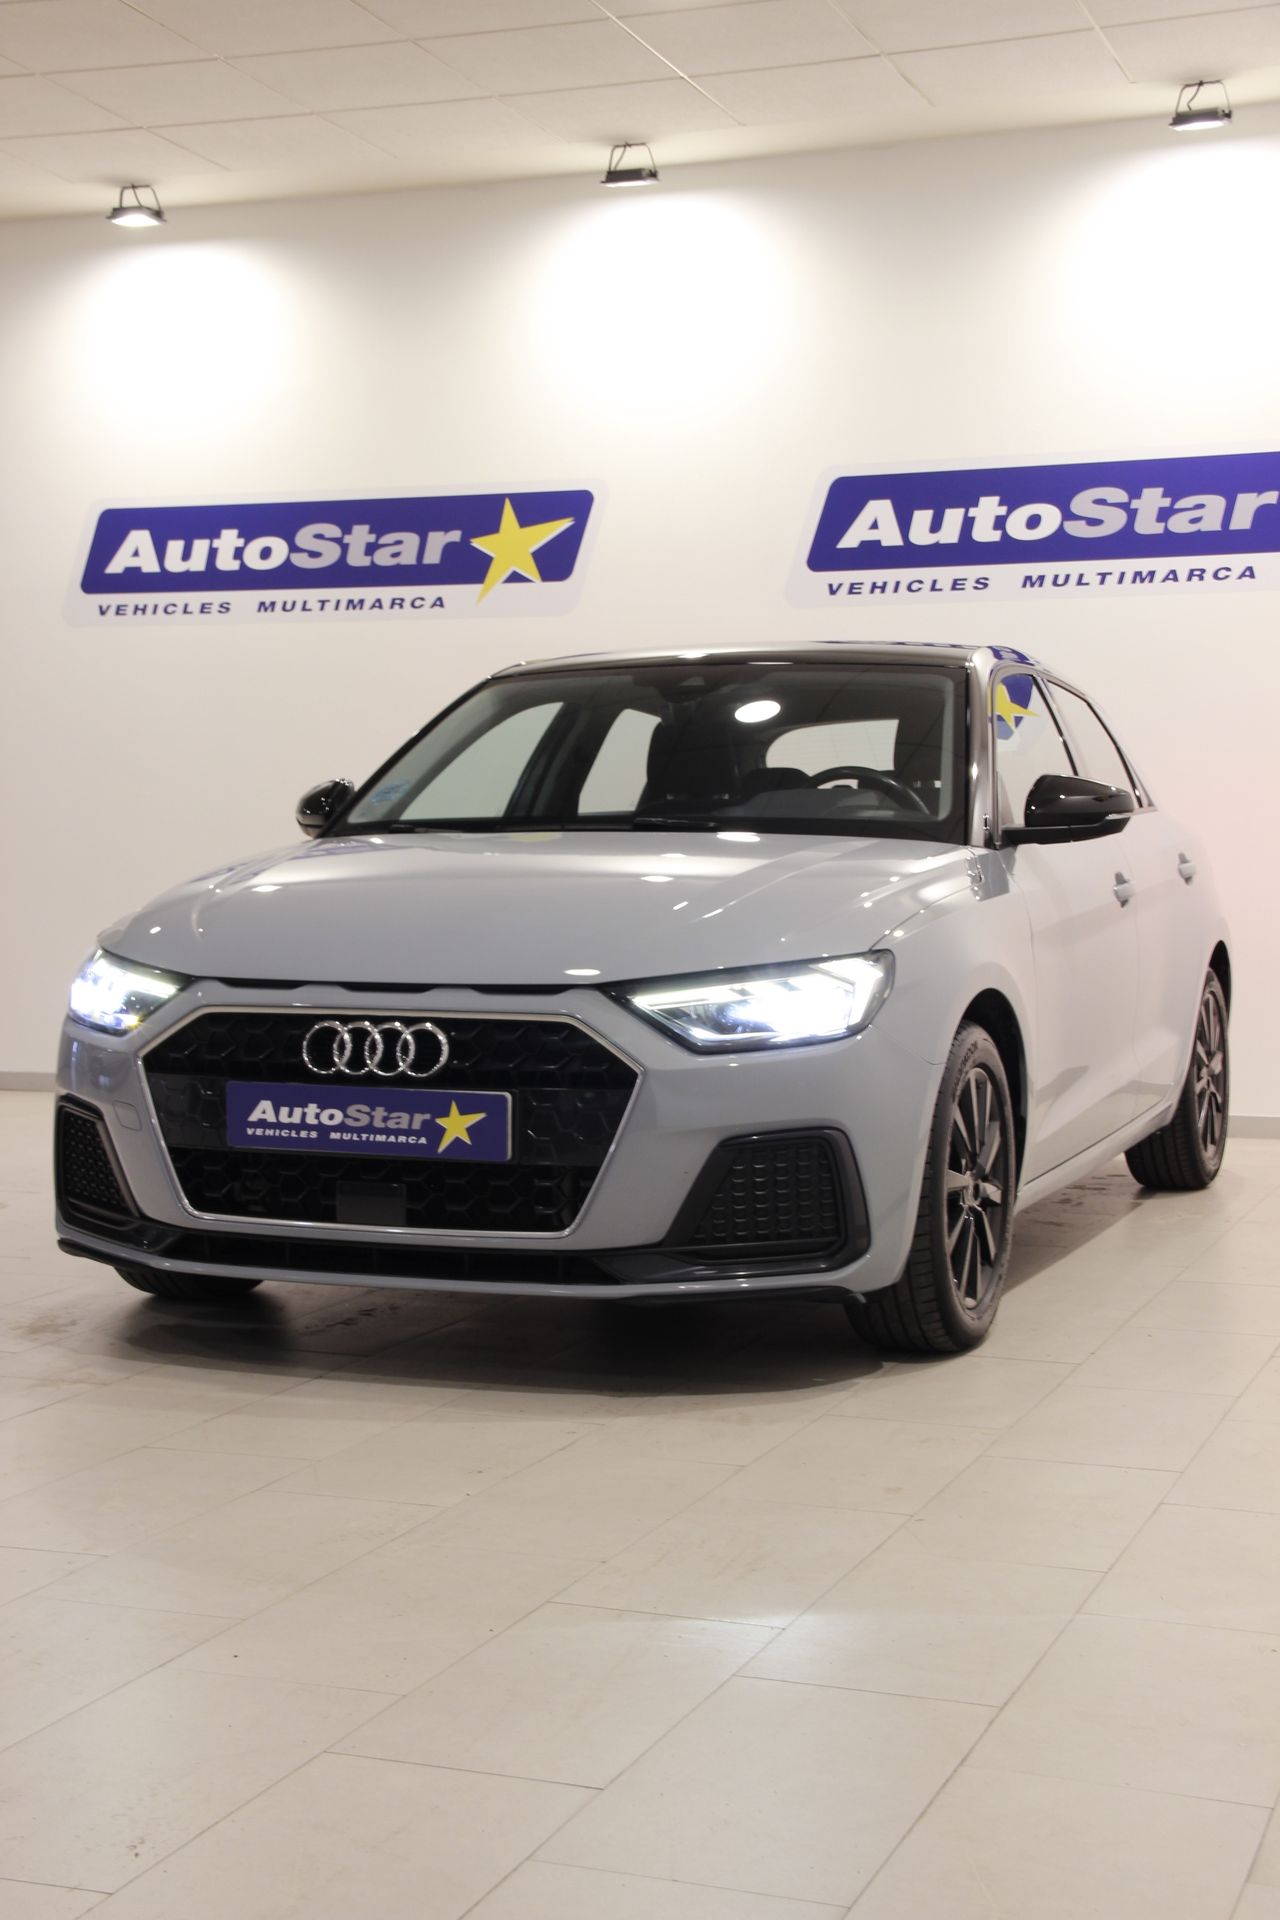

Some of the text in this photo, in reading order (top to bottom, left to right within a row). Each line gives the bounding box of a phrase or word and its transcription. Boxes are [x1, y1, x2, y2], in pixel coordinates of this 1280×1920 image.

[836, 486, 1280, 549] AutoStar
[104, 523, 462, 574] AutoStar
[827, 565, 1256, 596] VEHICLES MULTIMARCA
[98, 596, 445, 617] VEHICLES MULTIMARCA
[247, 1099, 431, 1131] AutoStar
[246, 1127, 428, 1145] VEHICLES MULTIMARCA
